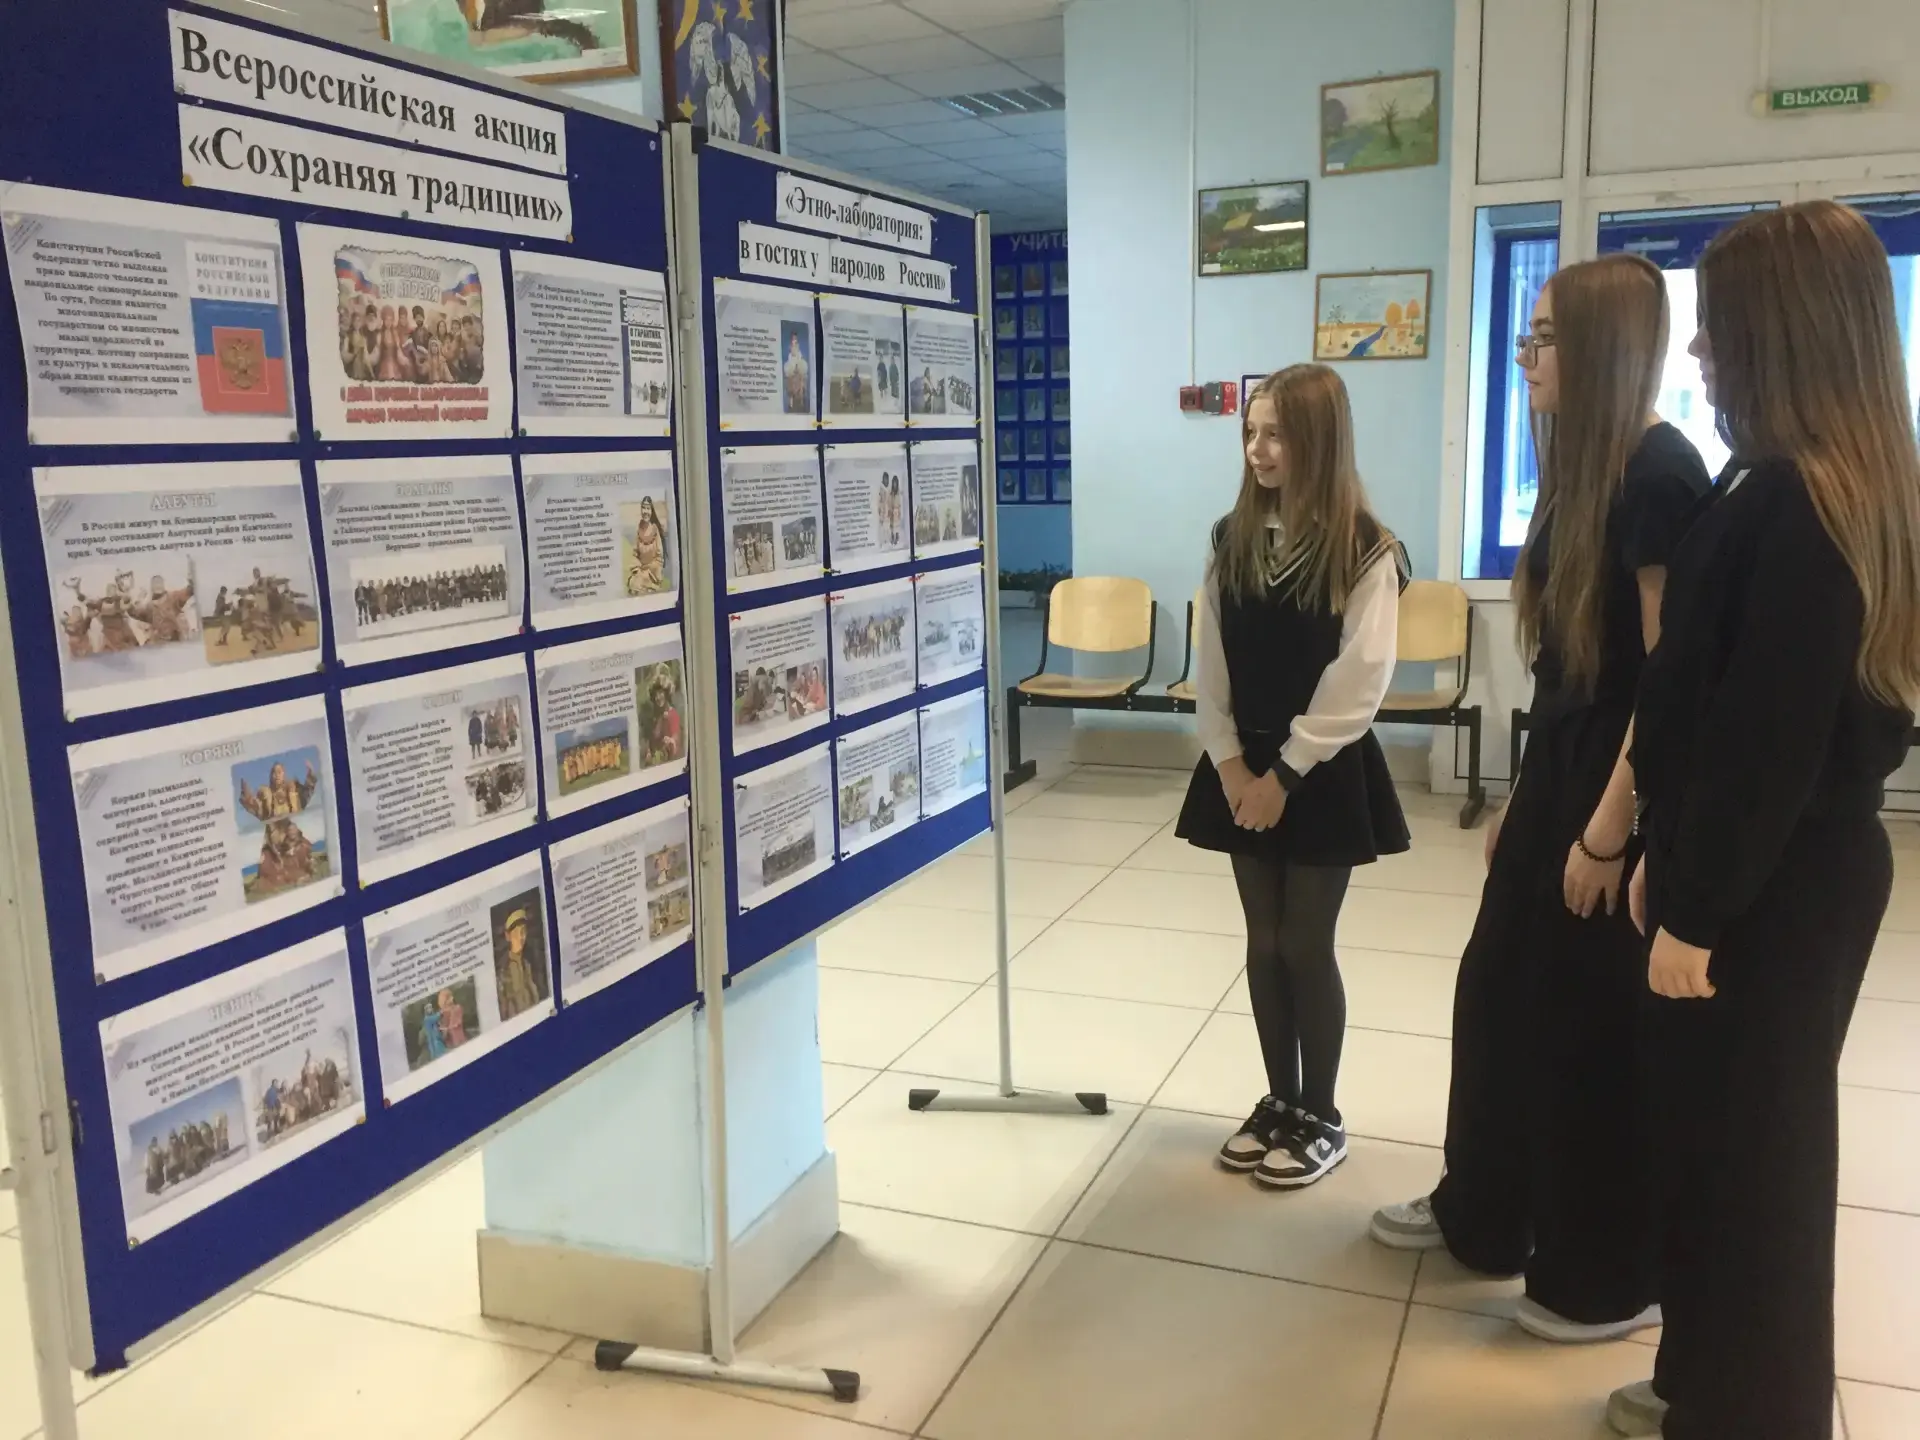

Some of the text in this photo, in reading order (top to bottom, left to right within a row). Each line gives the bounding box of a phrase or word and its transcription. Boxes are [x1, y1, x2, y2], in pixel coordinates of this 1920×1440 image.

[177, 27, 557, 155] Всероссийская акция
[1782, 86, 1859, 105] ВЫХОД
[188, 127, 563, 222] «Сохраняя традиции»
[785, 187, 923, 242] «Этно-лаборатория:
[740, 239, 946, 290] в гостях у народов России»
[182, 741, 243, 767] КОРЯКИ
